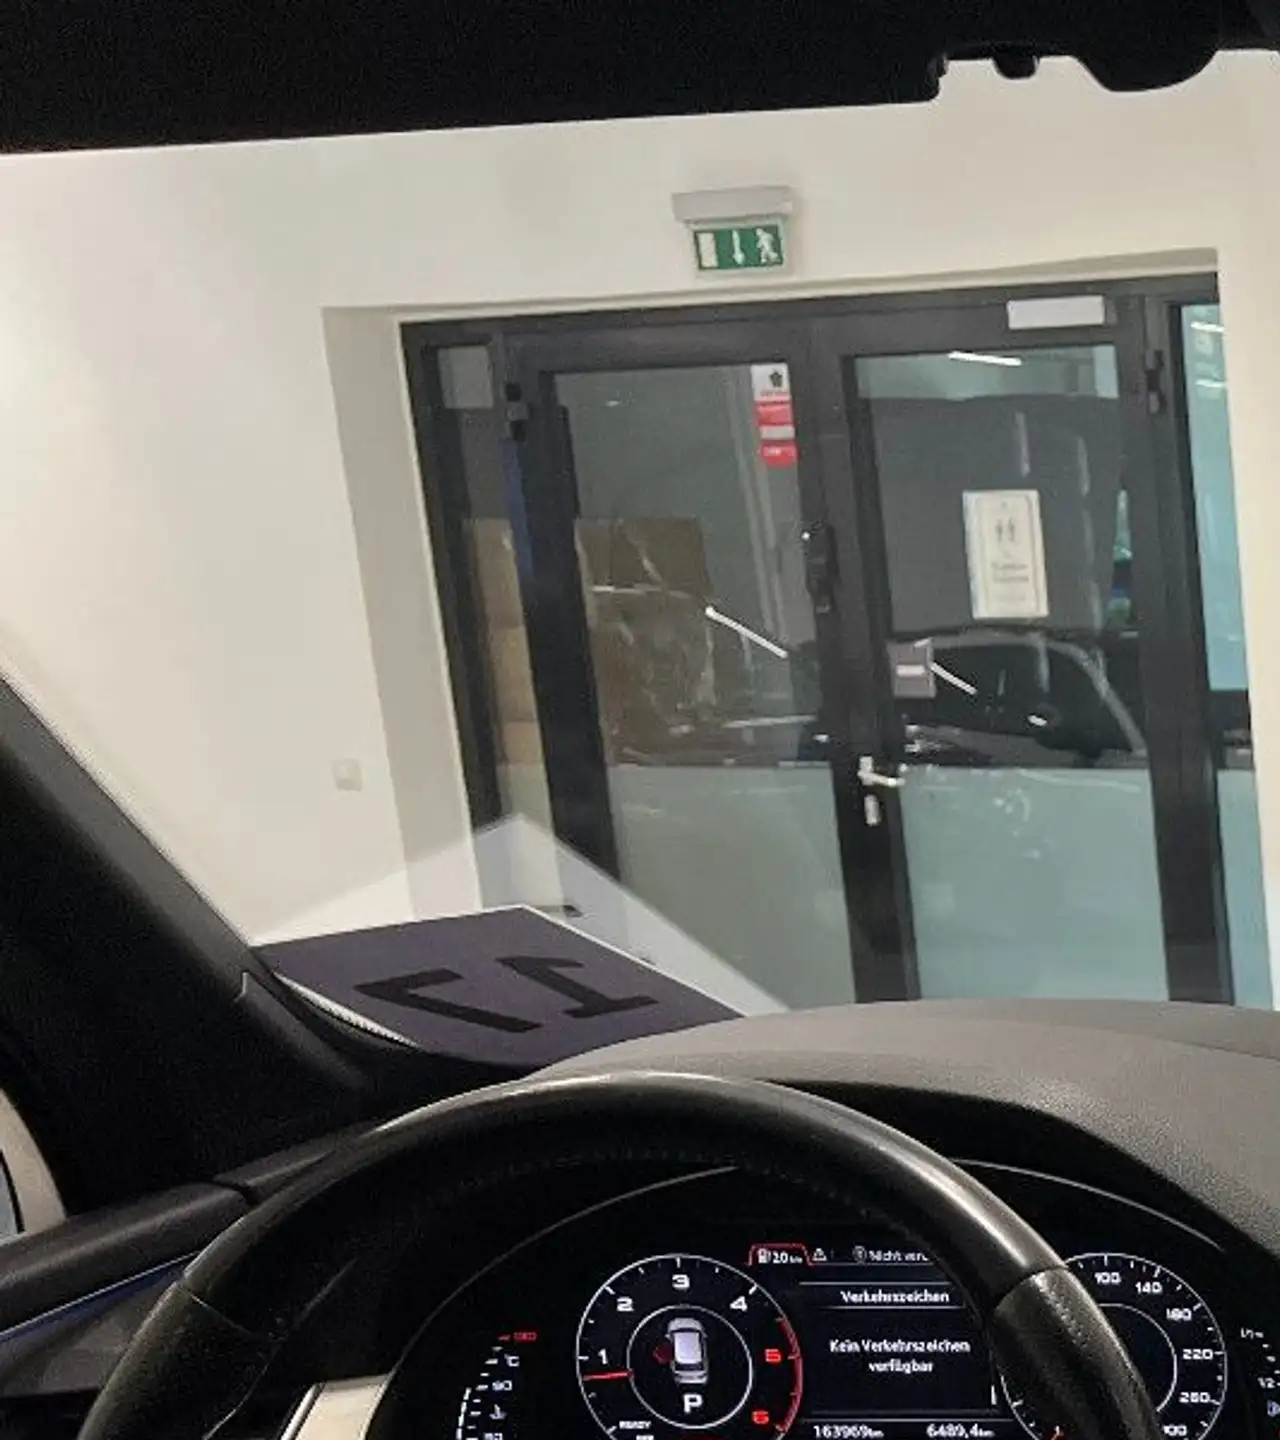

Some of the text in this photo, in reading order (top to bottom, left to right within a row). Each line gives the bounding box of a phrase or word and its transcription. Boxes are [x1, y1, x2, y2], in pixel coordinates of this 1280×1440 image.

[772, 1252, 787, 1263] 20
[672, 1275, 689, 1289] 3
[1094, 1271, 1122, 1285] 100
[1135, 1281, 1163, 1294] 140
[840, 1289, 950, 1303] Verkehrszeichen
[616, 1298, 634, 1313] 2
[729, 1297, 748, 1312] 4
[1166, 1308, 1193, 1322] 180
[830, 1339, 971, 1353] Kein Verkehrszeichen
[598, 1349, 609, 1365] 1
[765, 1348, 781, 1362] 5
[1182, 1348, 1214, 1361] 220
[868, 1358, 934, 1374] verfügbar
[684, 1395, 703, 1413] P
[1180, 1392, 1211, 1404] 260
[752, 1411, 769, 1425] 6
